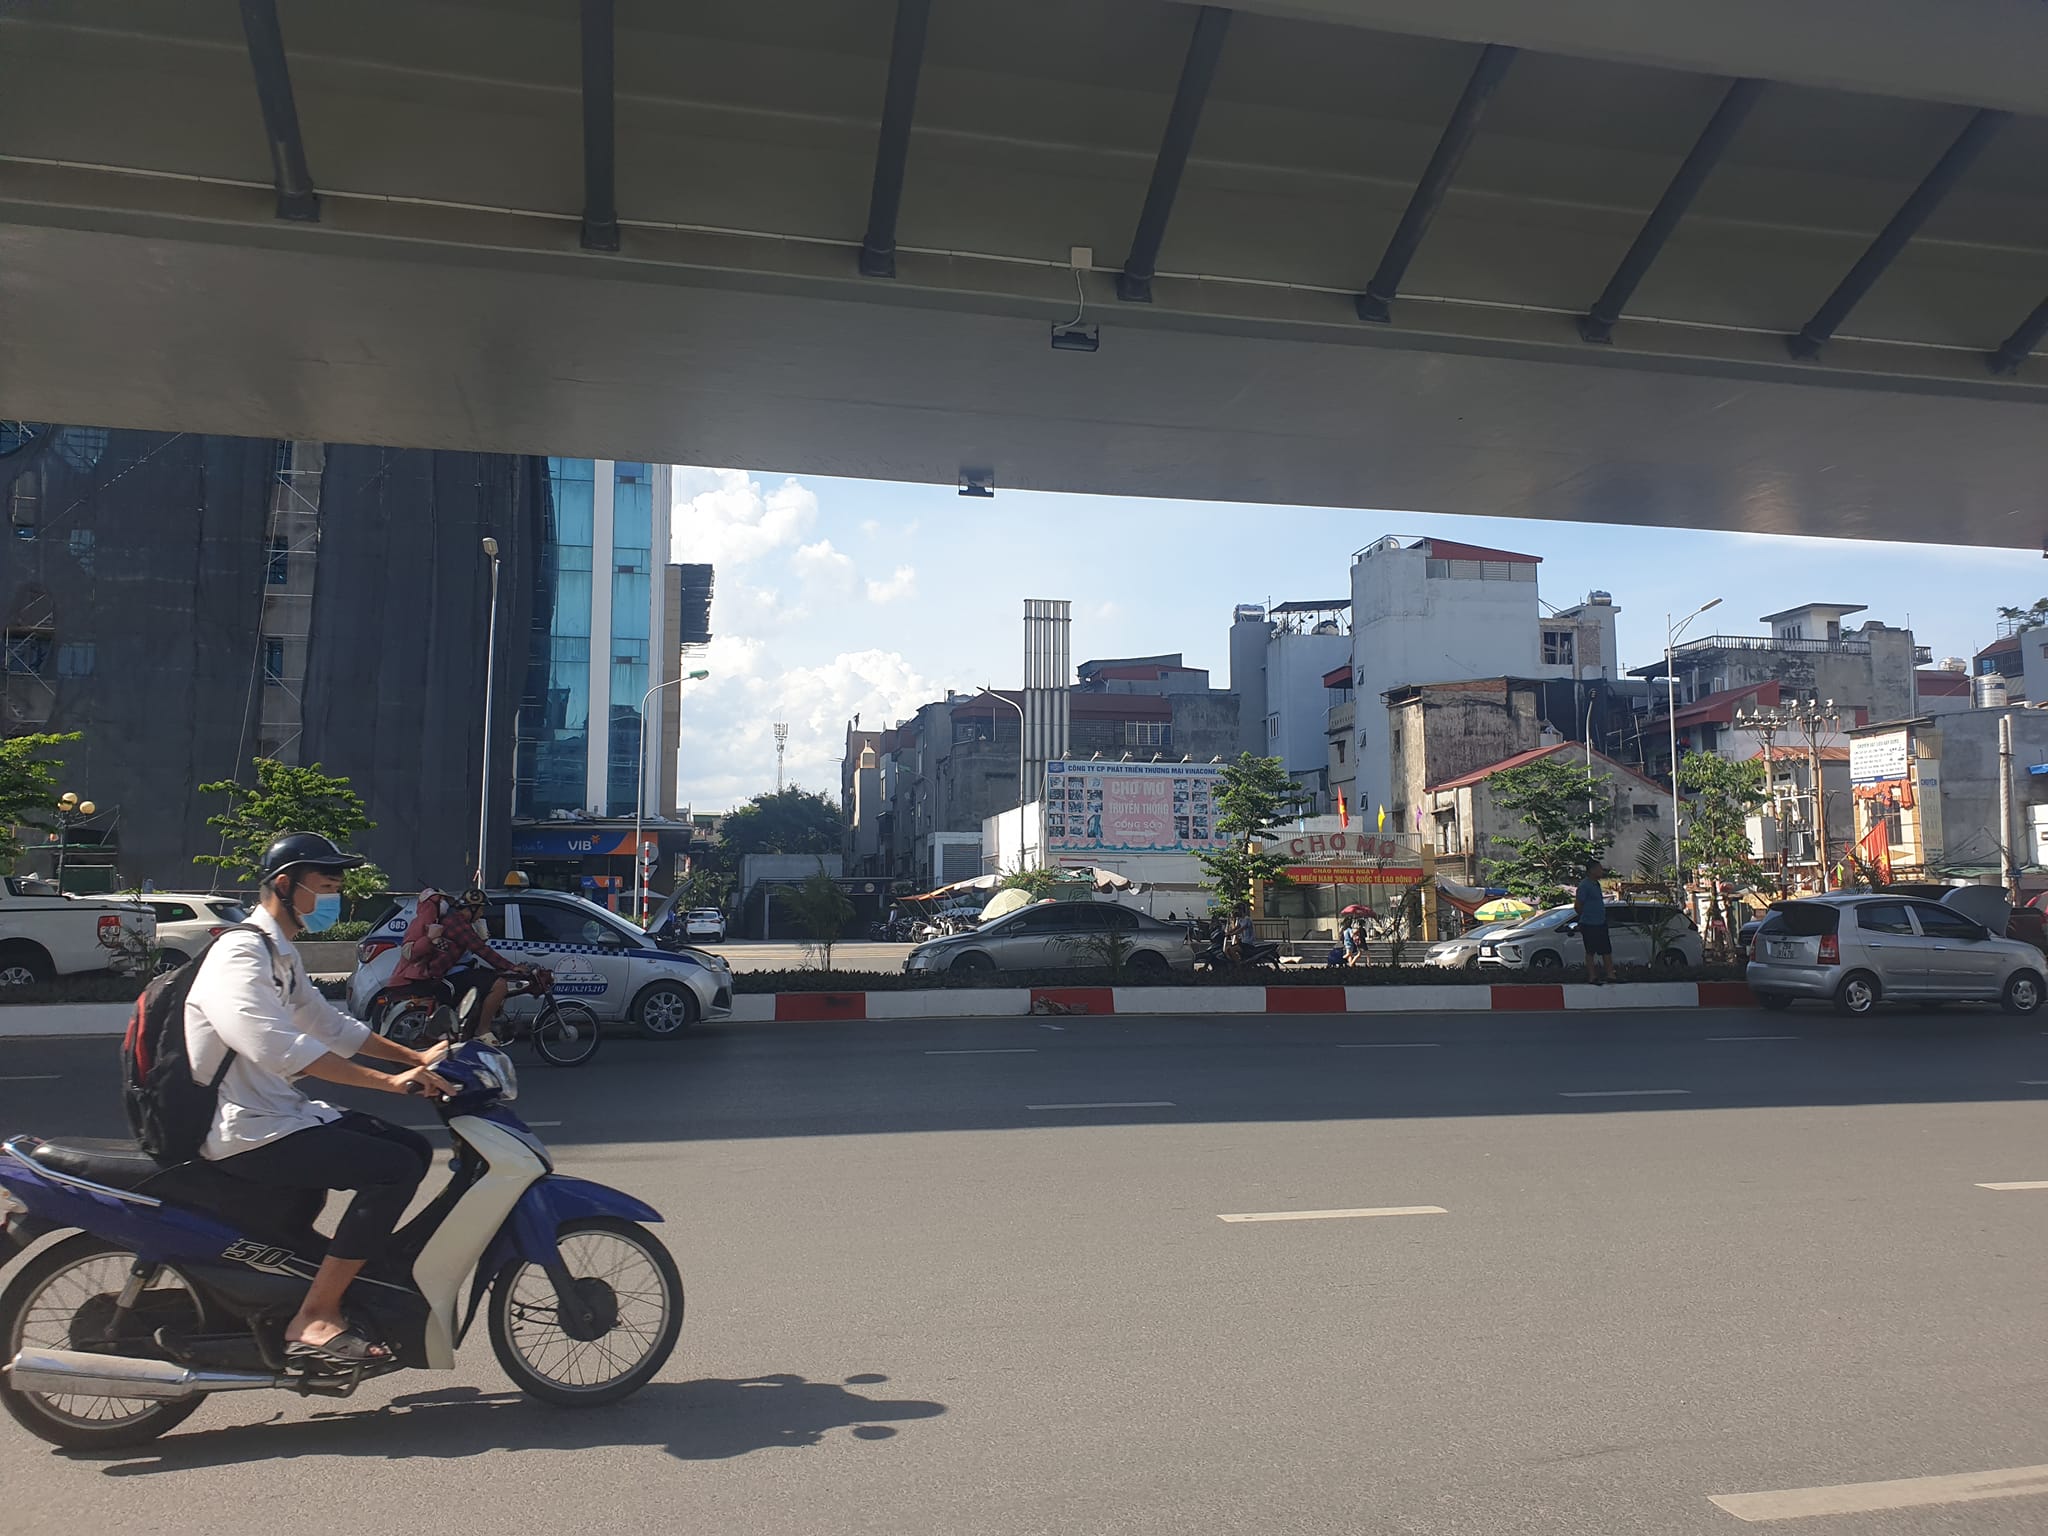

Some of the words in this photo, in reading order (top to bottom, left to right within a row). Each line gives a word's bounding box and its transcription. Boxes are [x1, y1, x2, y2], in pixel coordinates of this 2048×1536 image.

[1068, 764, 1086, 773] CÔNG
[1087, 765, 1095, 773] TY
[1096, 765, 1105, 773] CP
[1106, 765, 1123, 773] PHÁT
[1171, 767, 1184, 775] MẠI
[567, 839, 592, 851] VIB
[1290, 832, 1346, 857] CHỢ
[1356, 834, 1396, 858] MƠ
[1333, 867, 1355, 875] MỪNG
[1318, 874, 1334, 883] NAM
[1334, 875, 1348, 884] 30/4
[1355, 874, 1373, 884] QUỐC
[1374, 874, 1382, 884] TẾ
[1382, 876, 1394, 884] LAO
[1394, 875, 1413, 884] ĐỘNG
